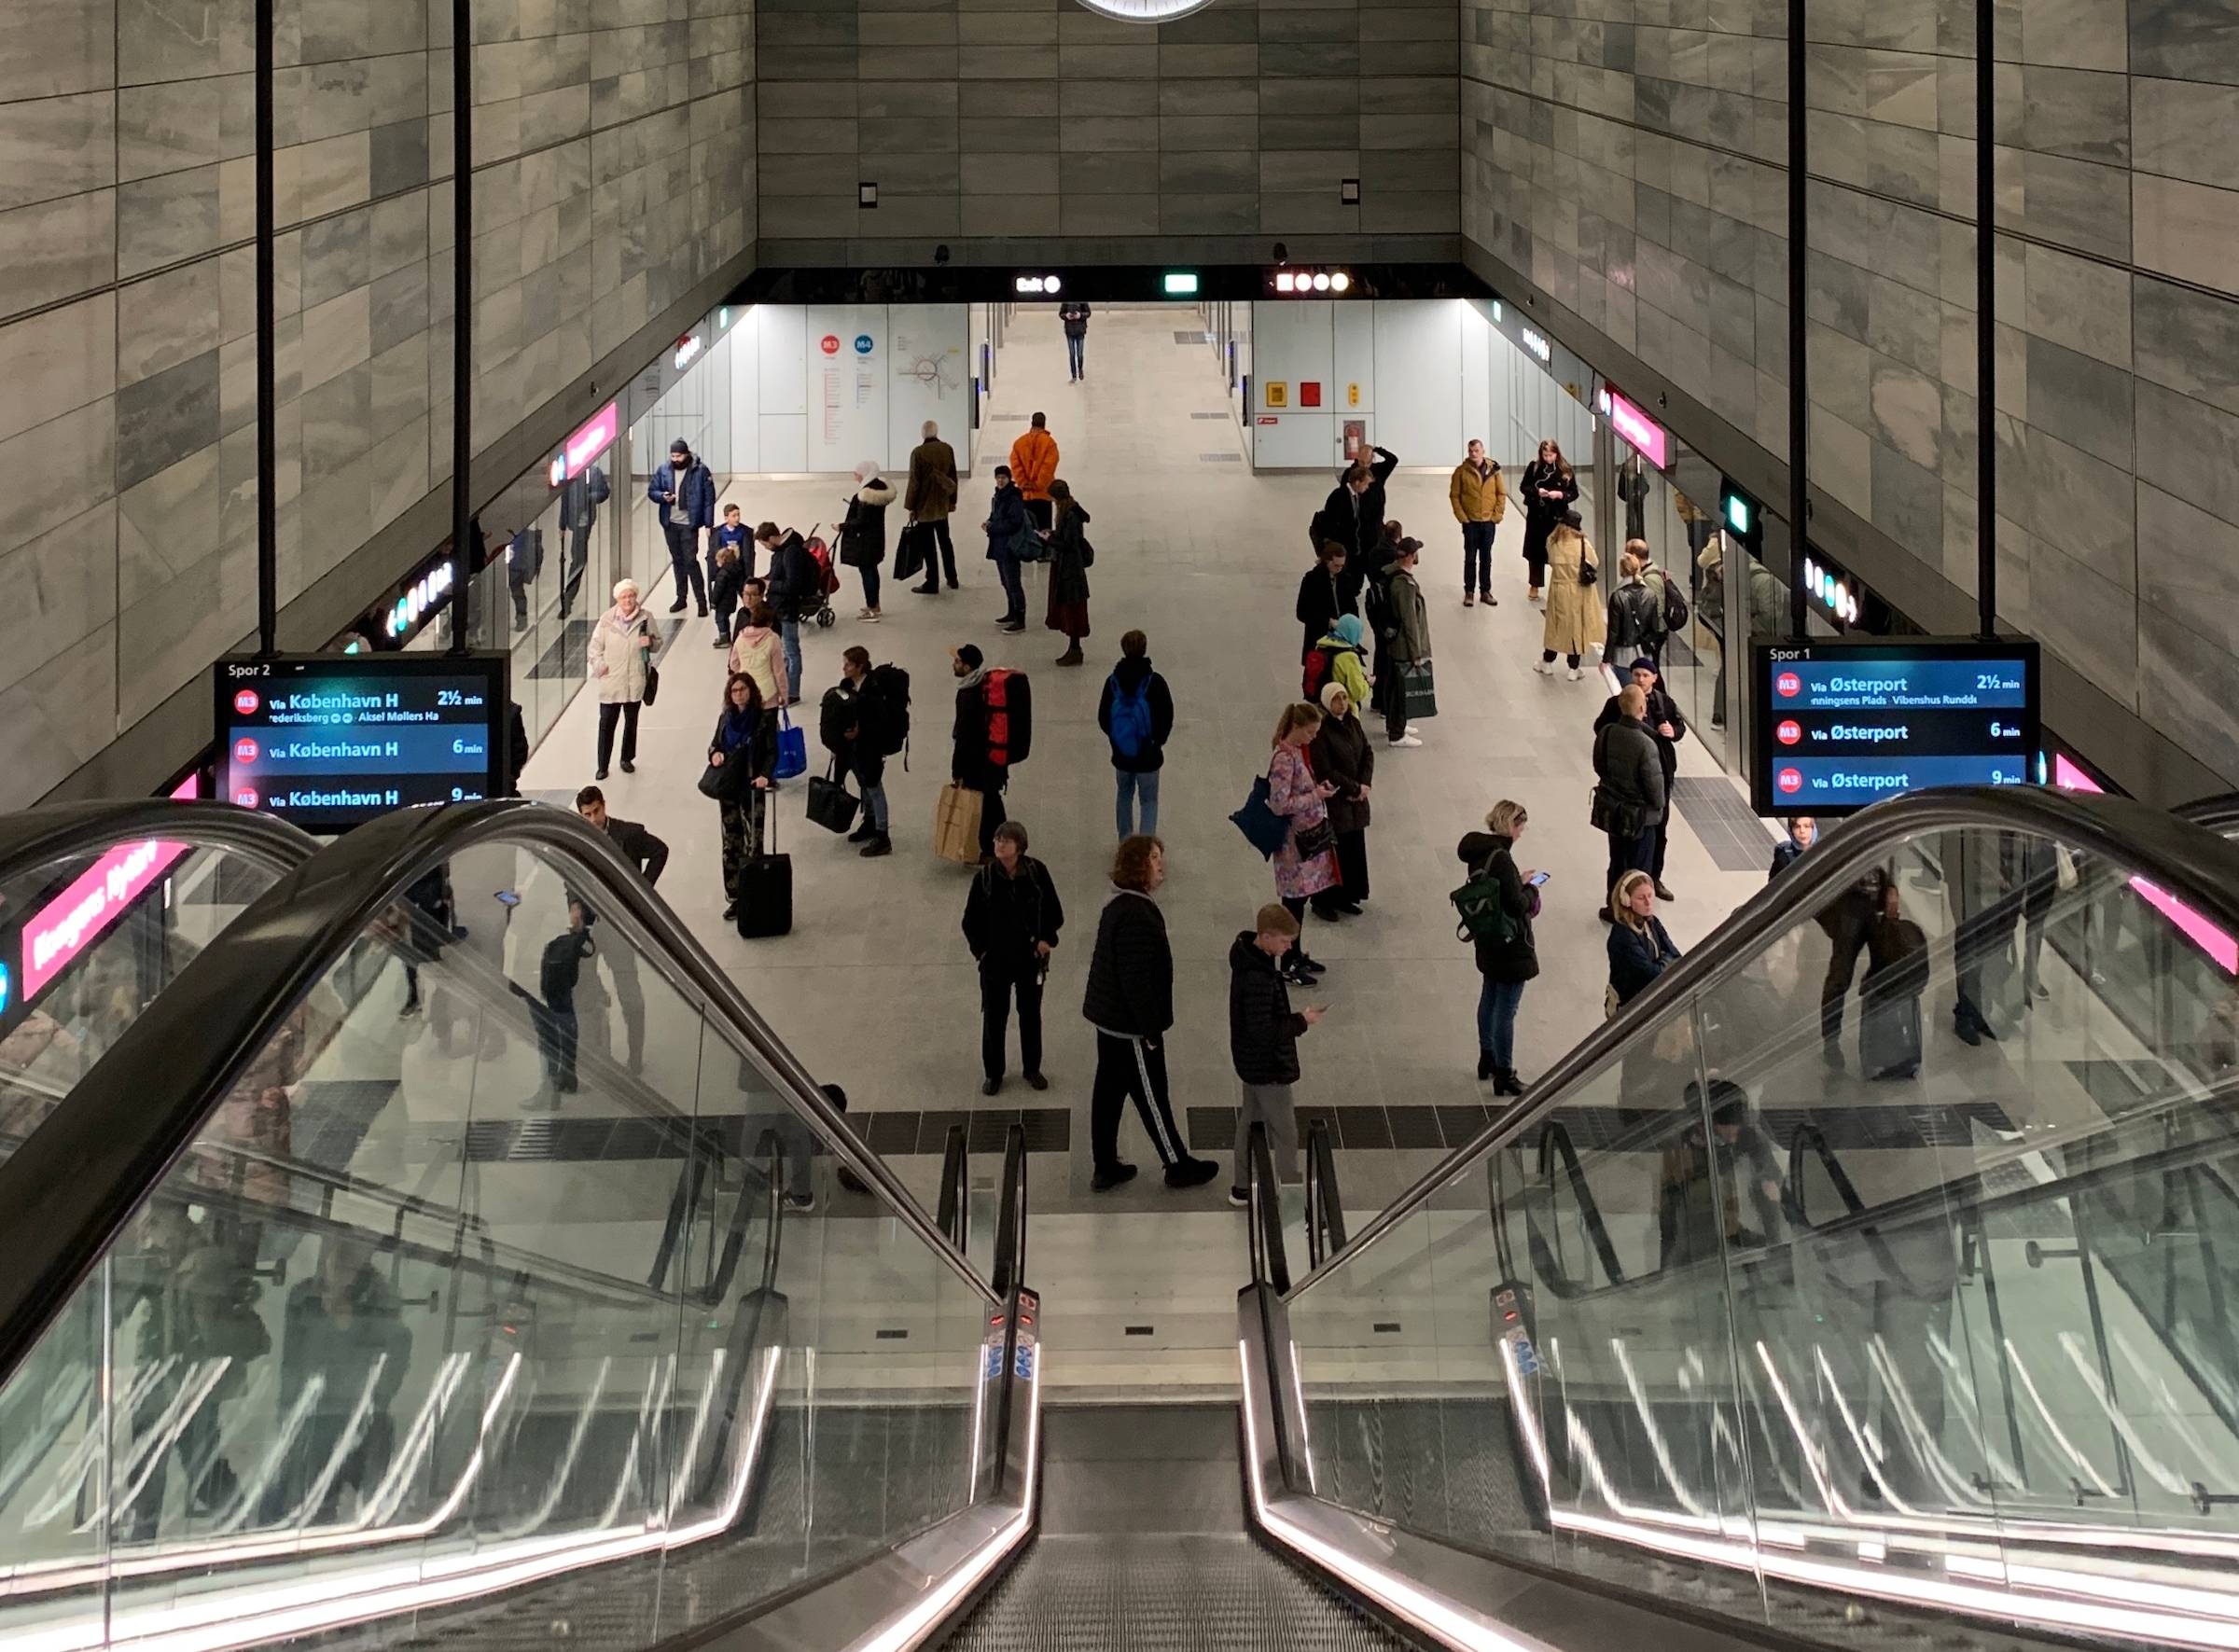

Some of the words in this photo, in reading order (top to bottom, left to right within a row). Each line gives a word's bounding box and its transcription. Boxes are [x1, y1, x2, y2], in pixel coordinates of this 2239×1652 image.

[1770, 648, 1800, 662] Spor
[1803, 647, 1810, 659] 1
[229, 664, 259, 678] Spor
[262, 664, 271, 675] 2
[1779, 679, 1798, 690] M3
[1830, 677, 1908, 695] Østerport
[2002, 680, 2021, 689] min
[238, 697, 257, 708] M3
[289, 693, 381, 709] København
[385, 693, 398, 708] H
[464, 696, 482, 705] min
[1861, 695, 1886, 705] Plads
[1892, 695, 1940, 704] Vibenshus
[358, 712, 385, 722] Aksel
[425, 711, 439, 721] Ha
[1780, 727, 1798, 738] M3
[1830, 725, 1909, 743] Østerport
[1990, 722, 2001, 737] 6
[2002, 728, 2021, 737] min
[237, 745, 256, 757] M3
[289, 742, 381, 757] København
[385, 742, 398, 757] H
[452, 740, 464, 754] 6
[464, 744, 482, 754] min
[1780, 774, 1799, 785] M3
[1831, 772, 1909, 790] Østerport
[1992, 770, 2002, 784] 9
[2003, 775, 2021, 784] min
[238, 793, 256, 806] M3
[289, 790, 381, 806] København
[385, 790, 398, 806] H
[451, 787, 463, 802] 9
